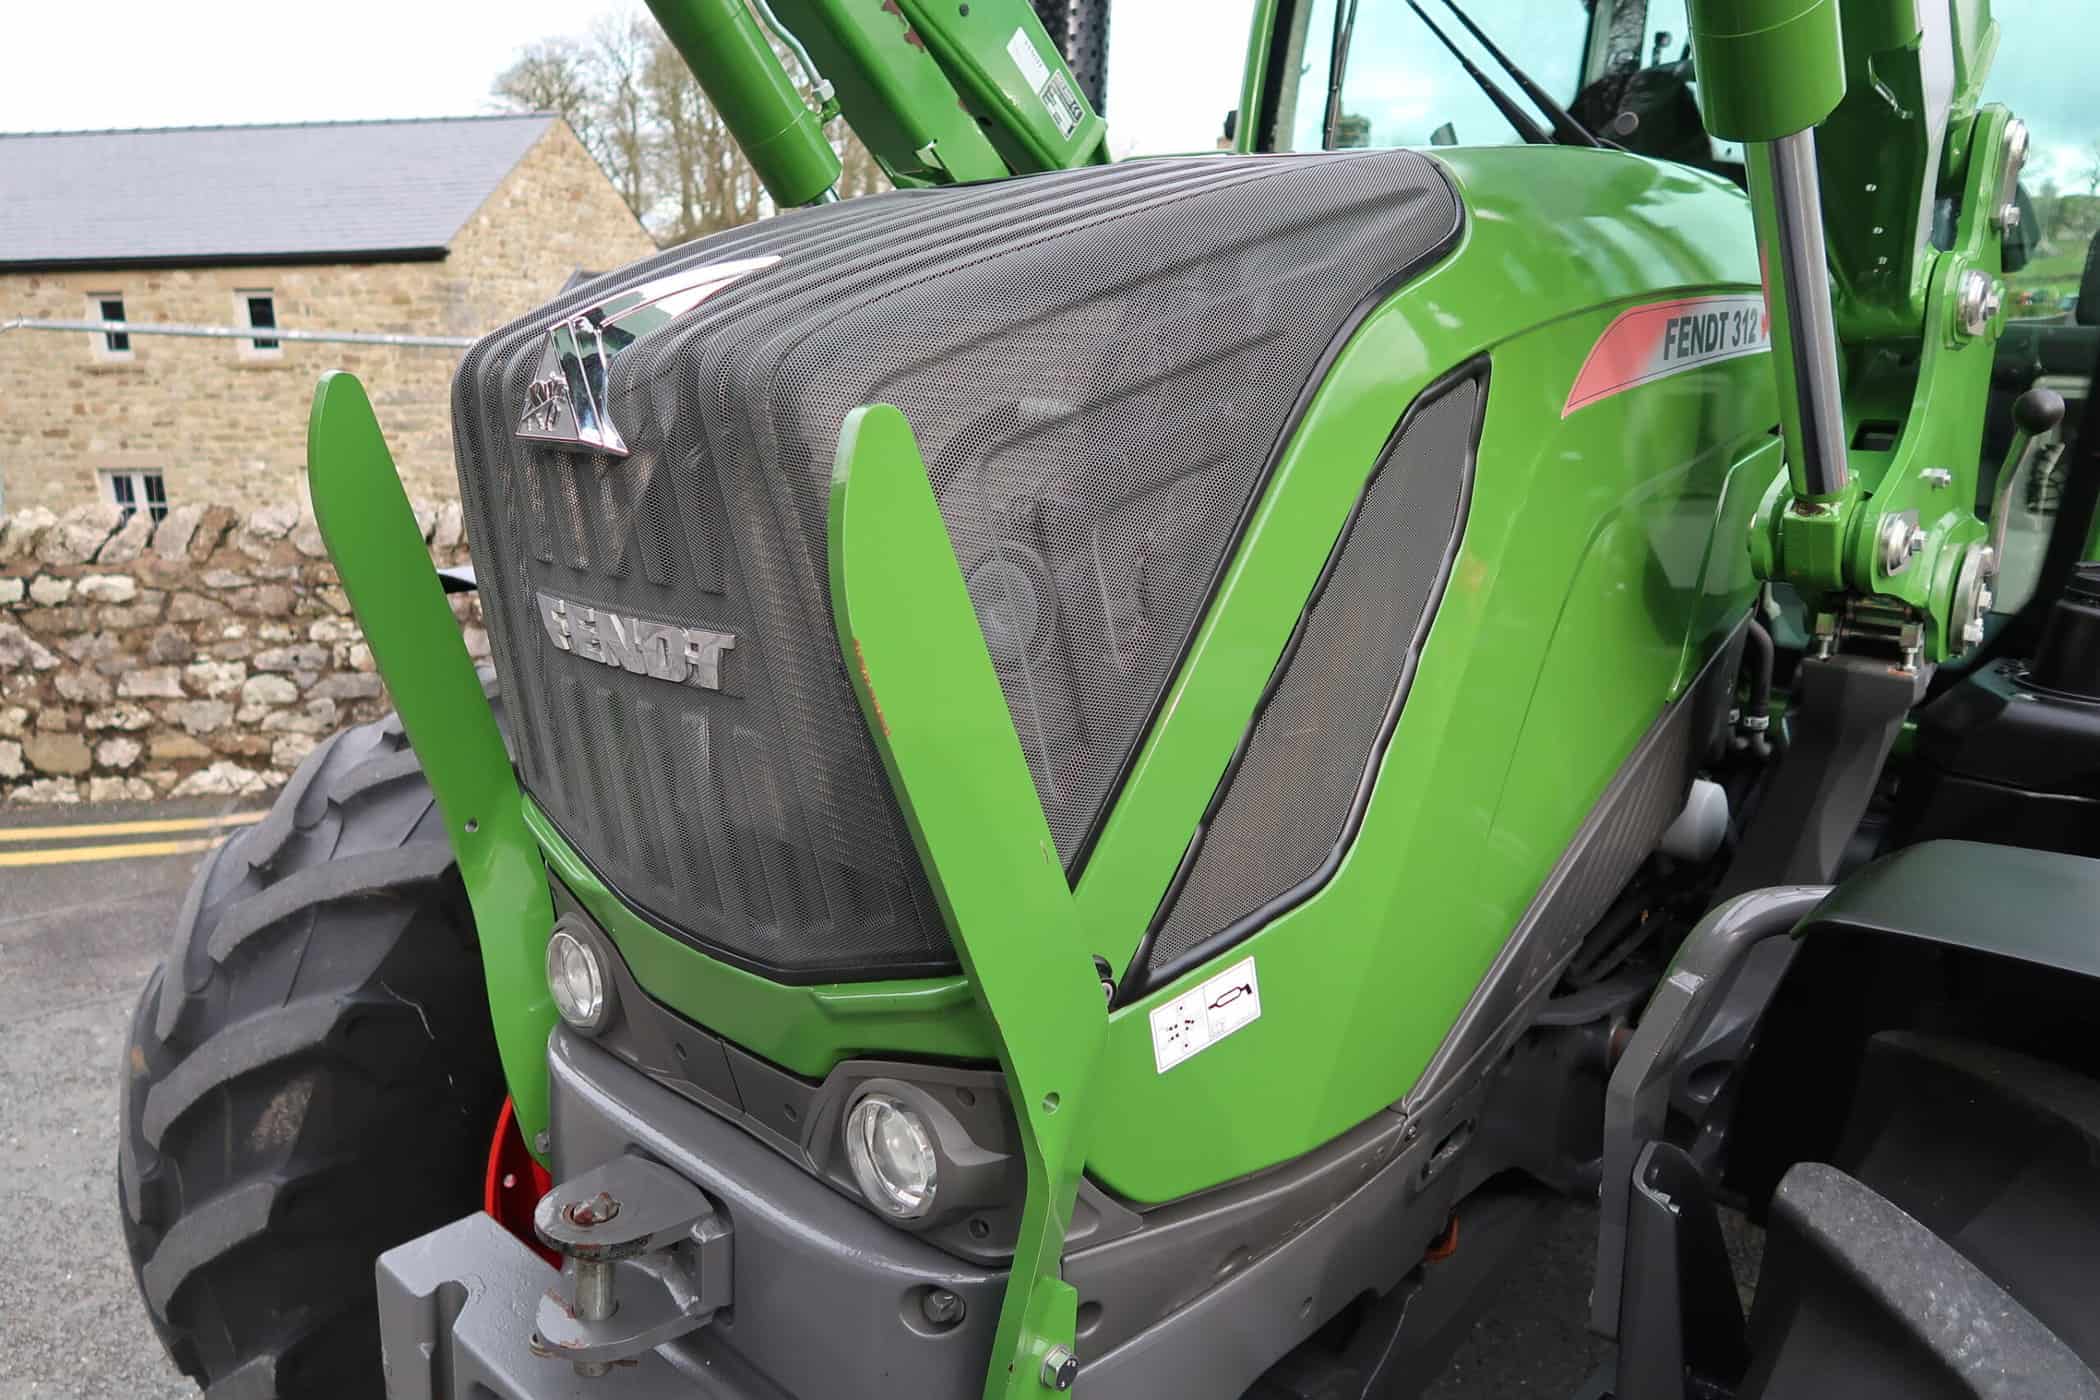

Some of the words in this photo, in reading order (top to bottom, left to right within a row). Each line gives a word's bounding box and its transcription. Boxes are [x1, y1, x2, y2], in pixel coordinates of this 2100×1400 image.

[1663, 311, 1729, 361] FENDT
[1732, 307, 1758, 347] 312
[535, 591, 736, 690] FENDT
